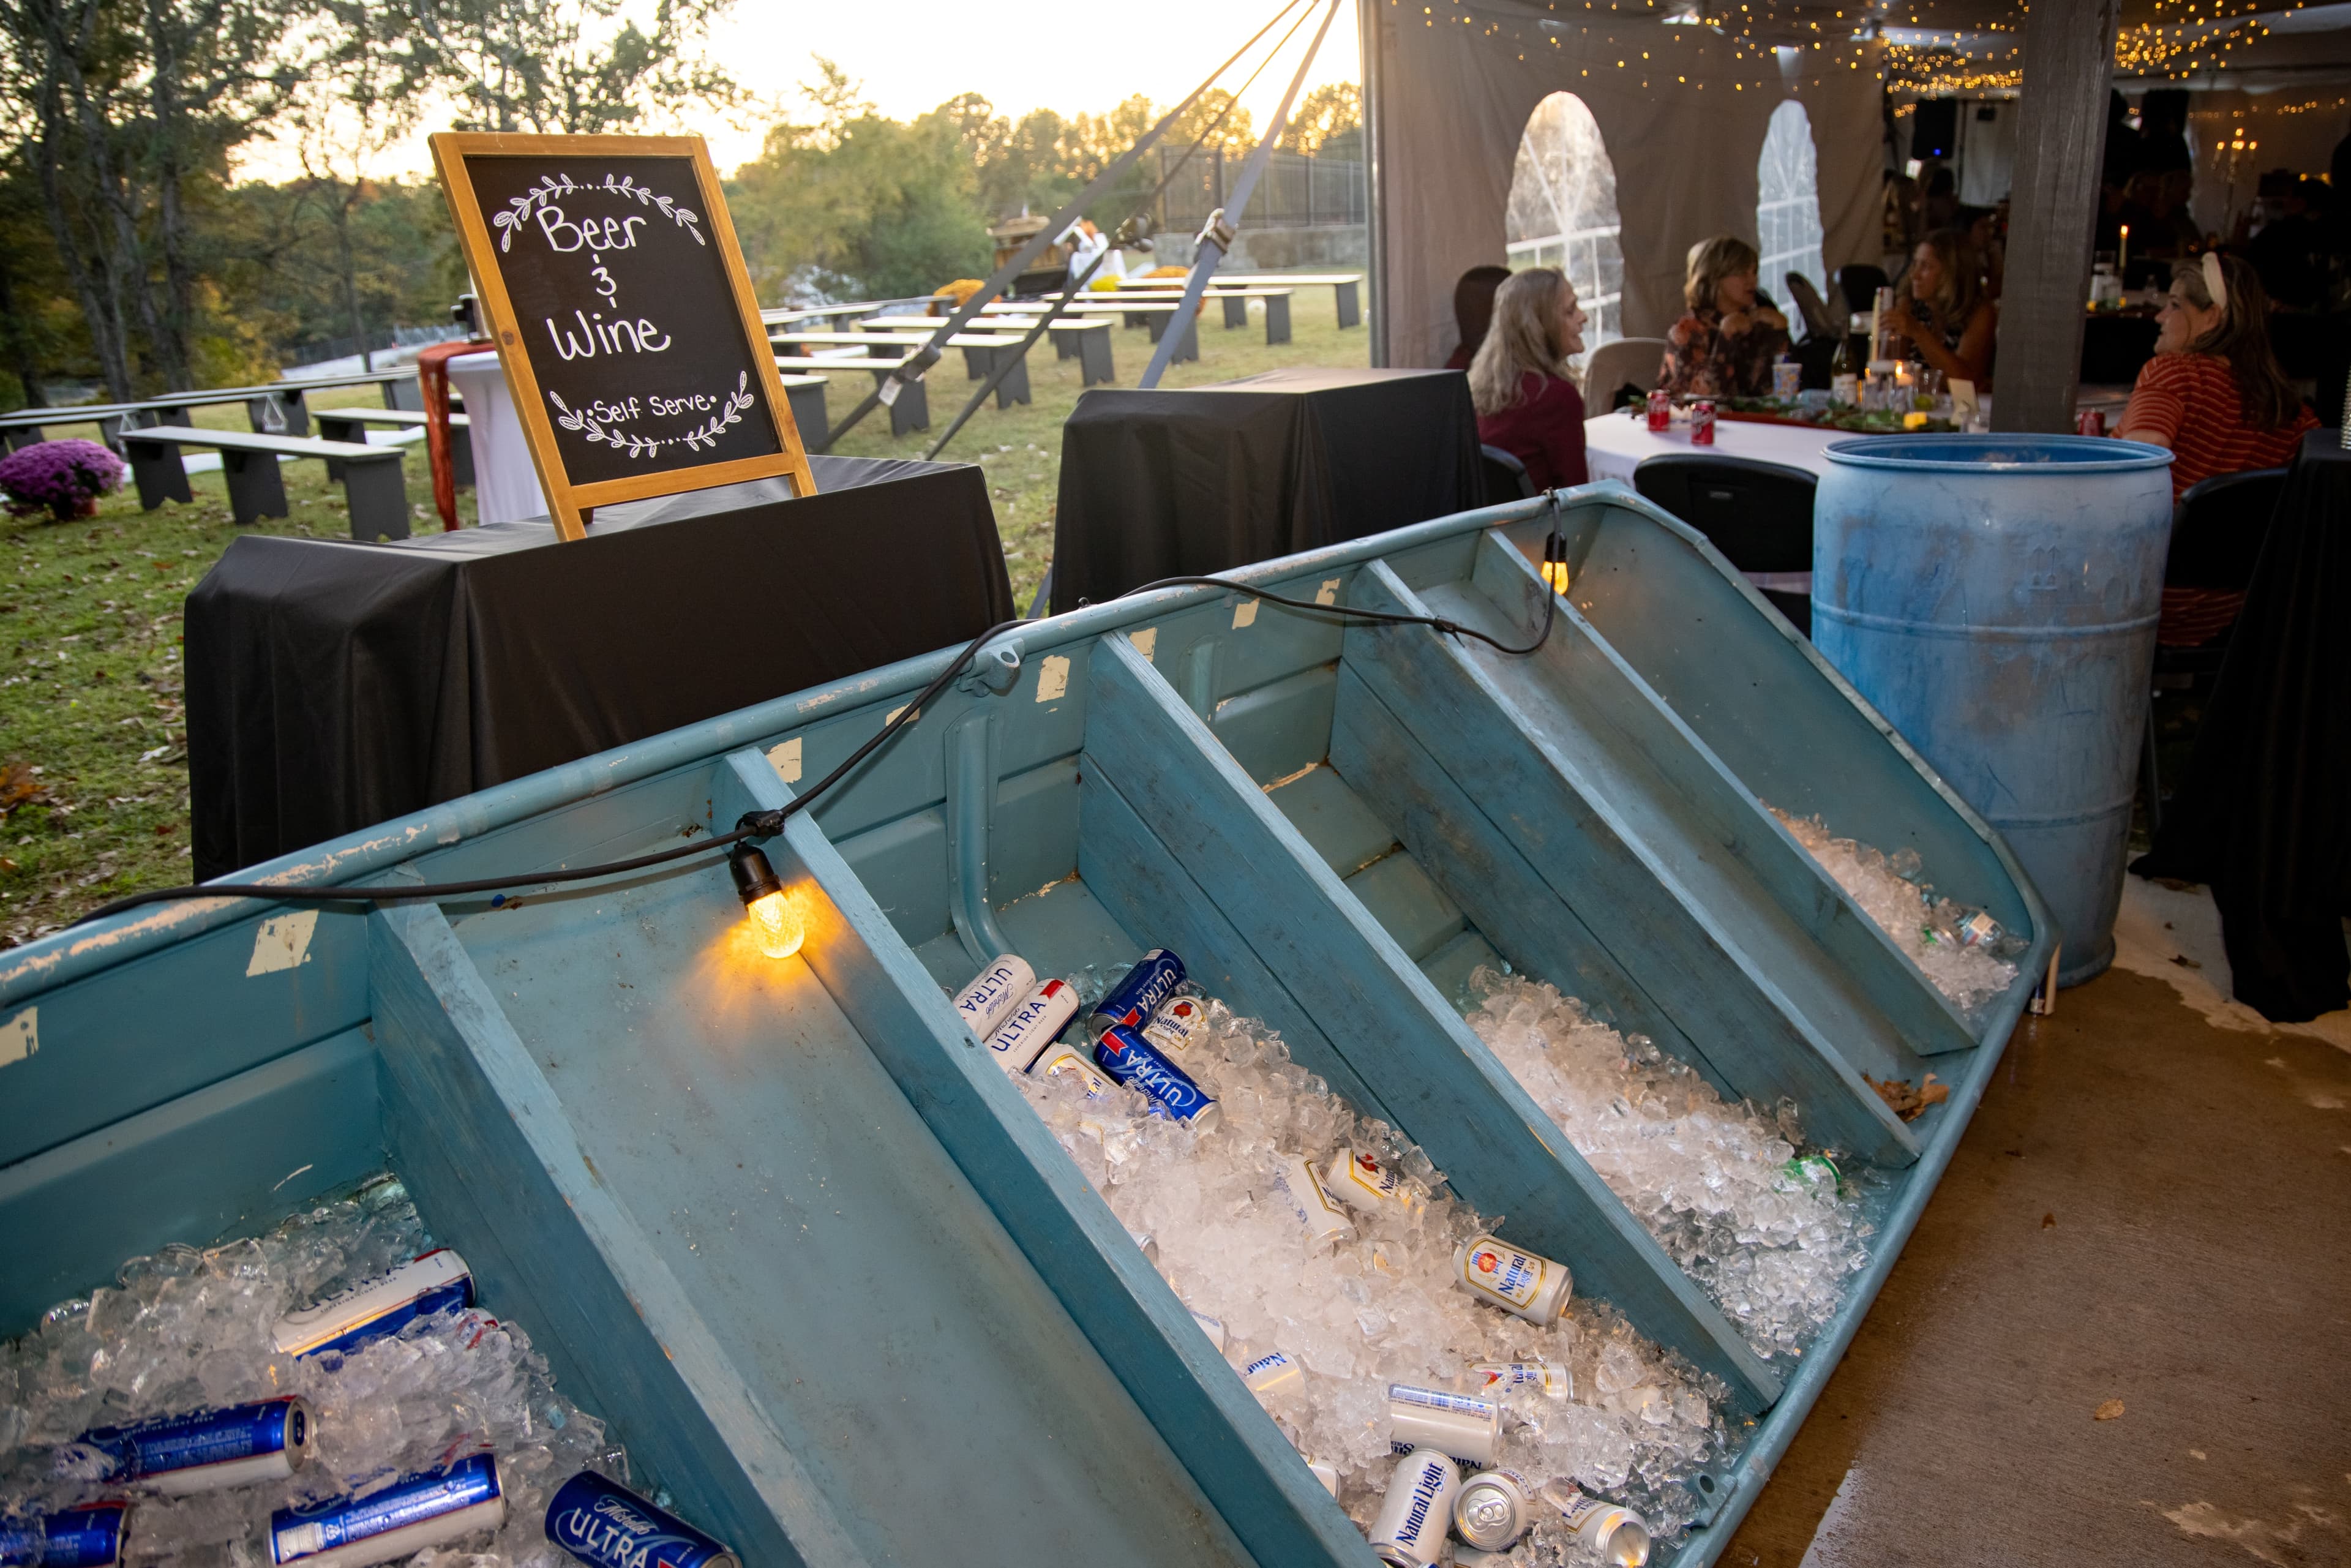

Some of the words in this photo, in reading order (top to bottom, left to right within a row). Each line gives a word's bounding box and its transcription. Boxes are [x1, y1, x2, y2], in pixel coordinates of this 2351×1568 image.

[536, 206, 647, 252] Beer
[546, 310, 671, 360] Wine
[593, 397, 641, 423] Self
[649, 394, 711, 416] Serve
[960, 968, 1013, 1012] ULTRA
[986, 983, 1014, 1019] Michelob
[1136, 969, 1177, 1011] ULTRA
[991, 1001, 1047, 1052] ULTRA
[1013, 1035, 1029, 1052] SUPERIOR
[1038, 1015, 1047, 1025] BEER
[1155, 1016, 1189, 1038] Natural
[1125, 1049, 1182, 1106] ULTRA
[1498, 1254, 1527, 1296] Natural
[1516, 1267, 1532, 1288] Light
[1243, 1352, 1288, 1376] Natur
[594, 1499, 651, 1535] Michelob
[1395, 1496, 1430, 1547] Natural
[1415, 1462, 1445, 1499] Light
[569, 1507, 649, 1568] ULTRA
